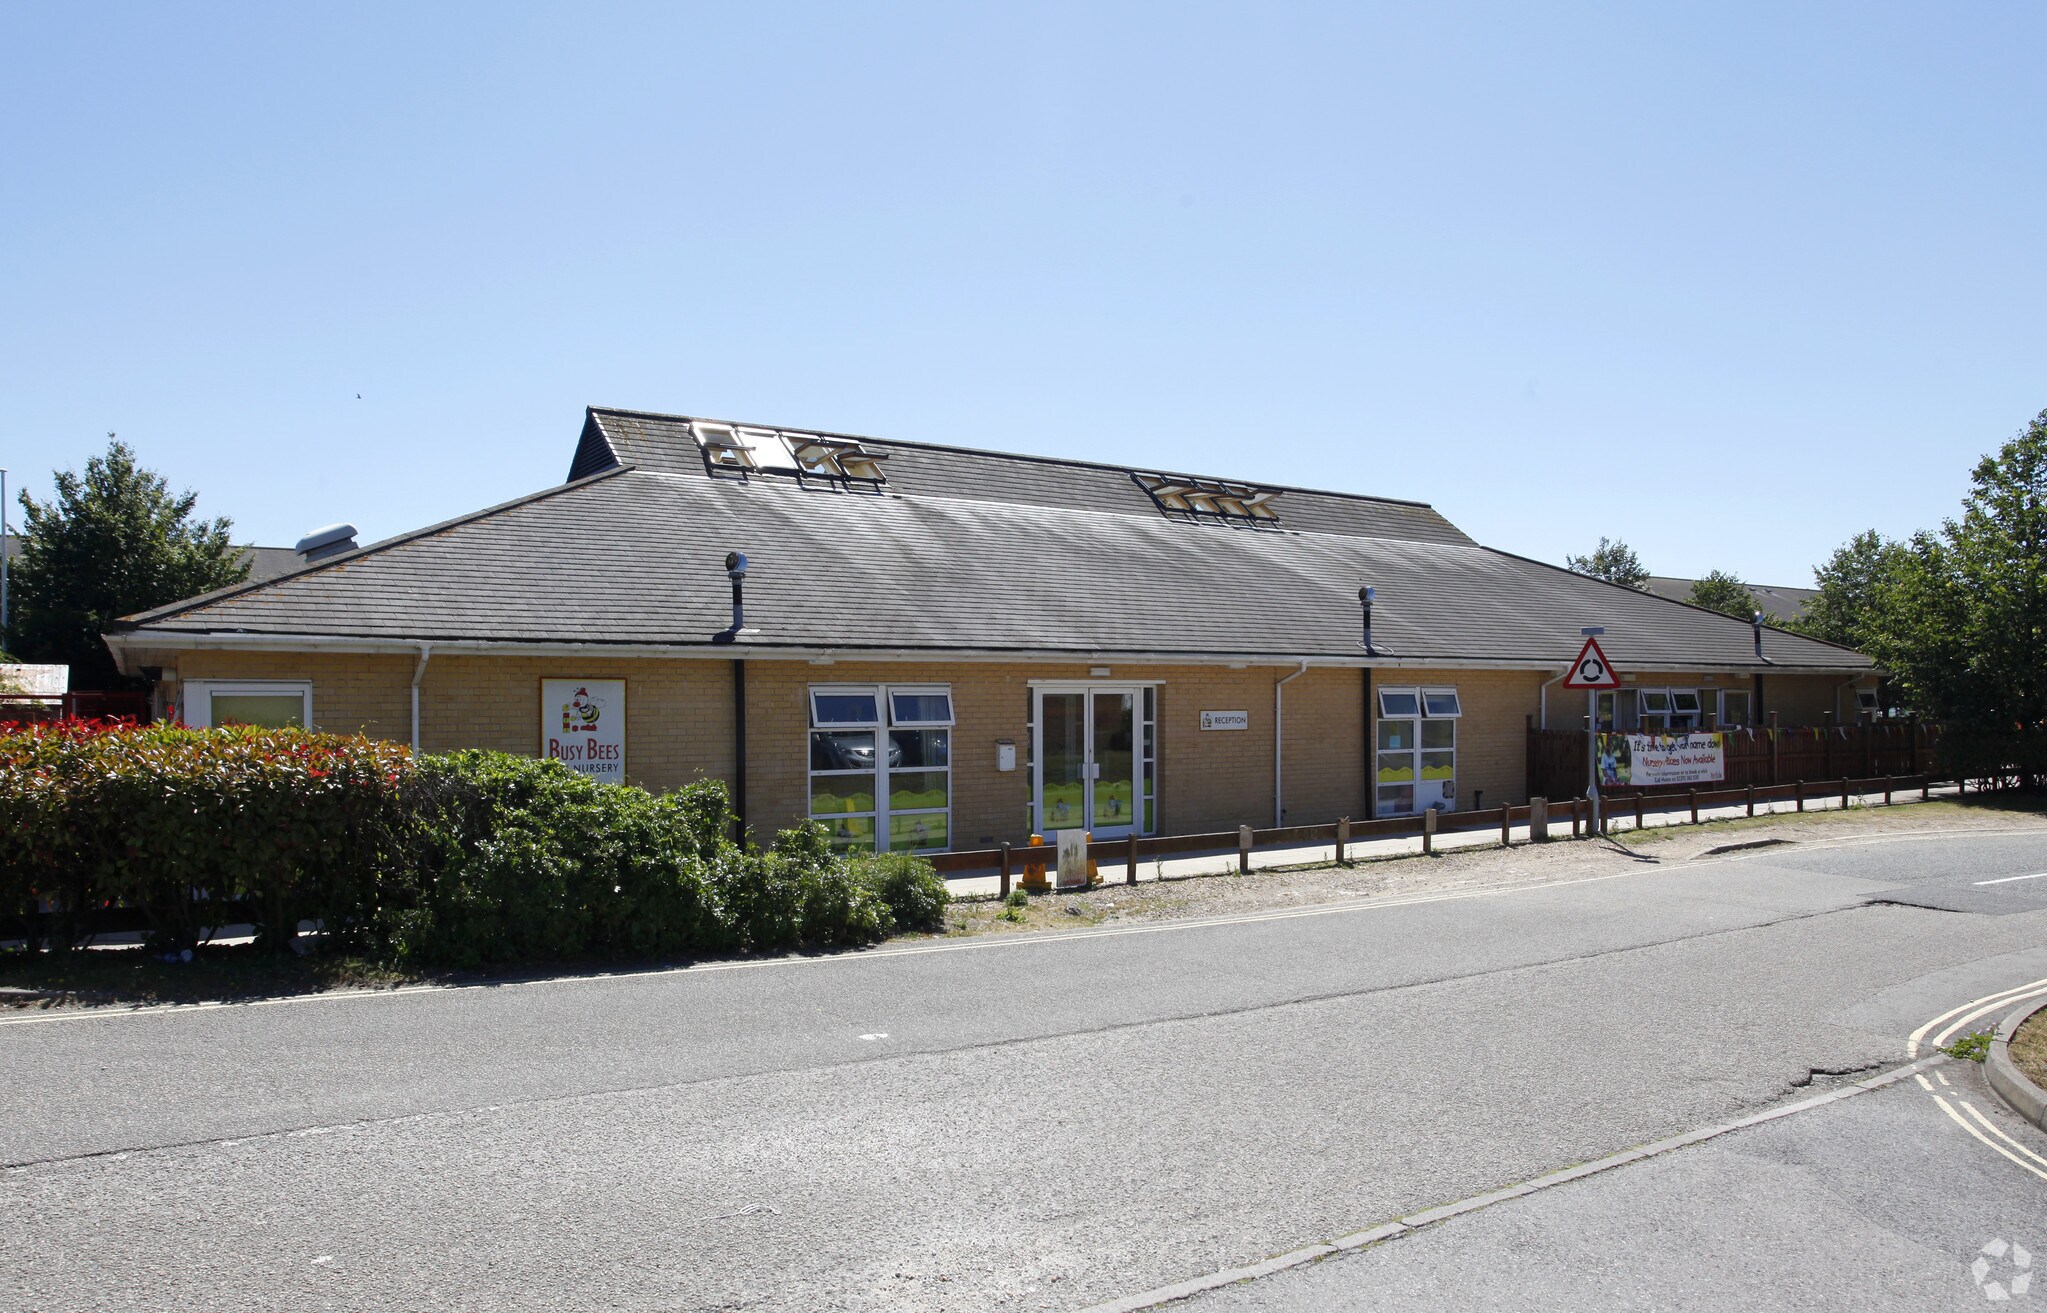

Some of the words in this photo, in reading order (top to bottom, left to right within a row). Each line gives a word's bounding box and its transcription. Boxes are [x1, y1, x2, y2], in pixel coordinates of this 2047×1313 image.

[1214, 716, 1246, 724] RECEPTION
[549, 738, 583, 760] BUSY
[587, 738, 619, 760] BEES
[1666, 742, 1677, 755] get
[1690, 740, 1704, 750] name
[573, 763, 619, 773] NURSERY
[1642, 757, 1663, 769] Nursery
[1681, 755, 1692, 764] Now
[1693, 754, 1715, 765] Available
